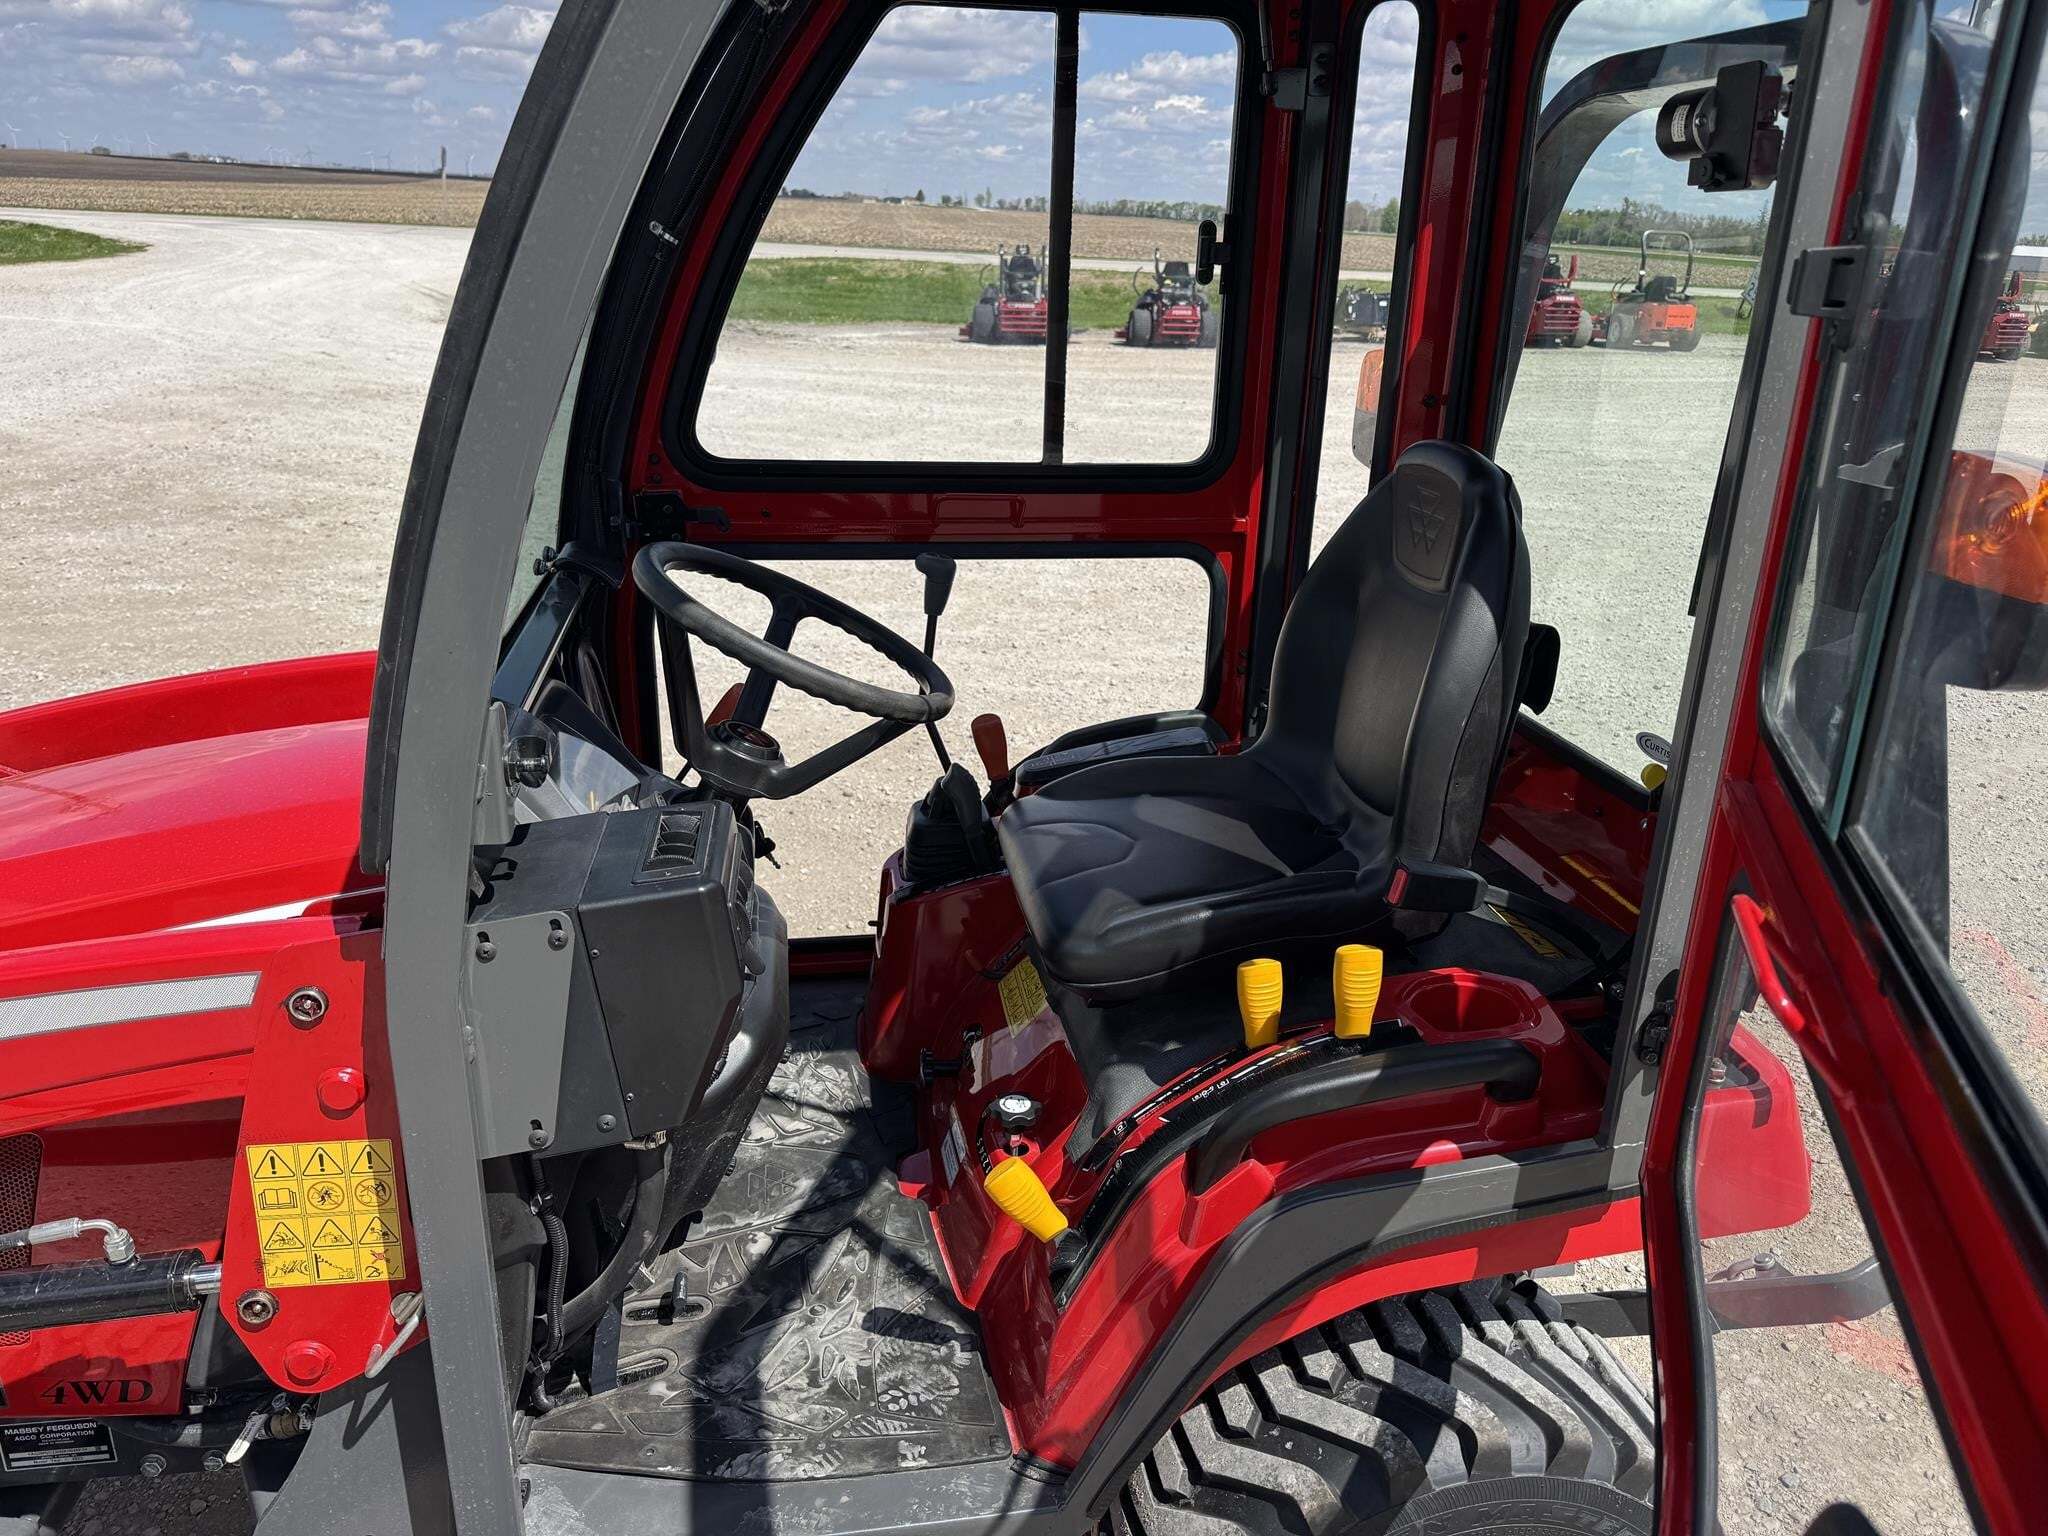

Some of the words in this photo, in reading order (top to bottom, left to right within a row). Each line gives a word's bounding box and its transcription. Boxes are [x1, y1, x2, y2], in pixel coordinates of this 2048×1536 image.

[41, 1379, 153, 1405] 4WD
[4, 1426, 44, 1436] MASSEY
[46, 1422, 97, 1431] FERGUSON
[14, 1434, 36, 1442] AGCO
[39, 1429, 95, 1440] CORPORATION
